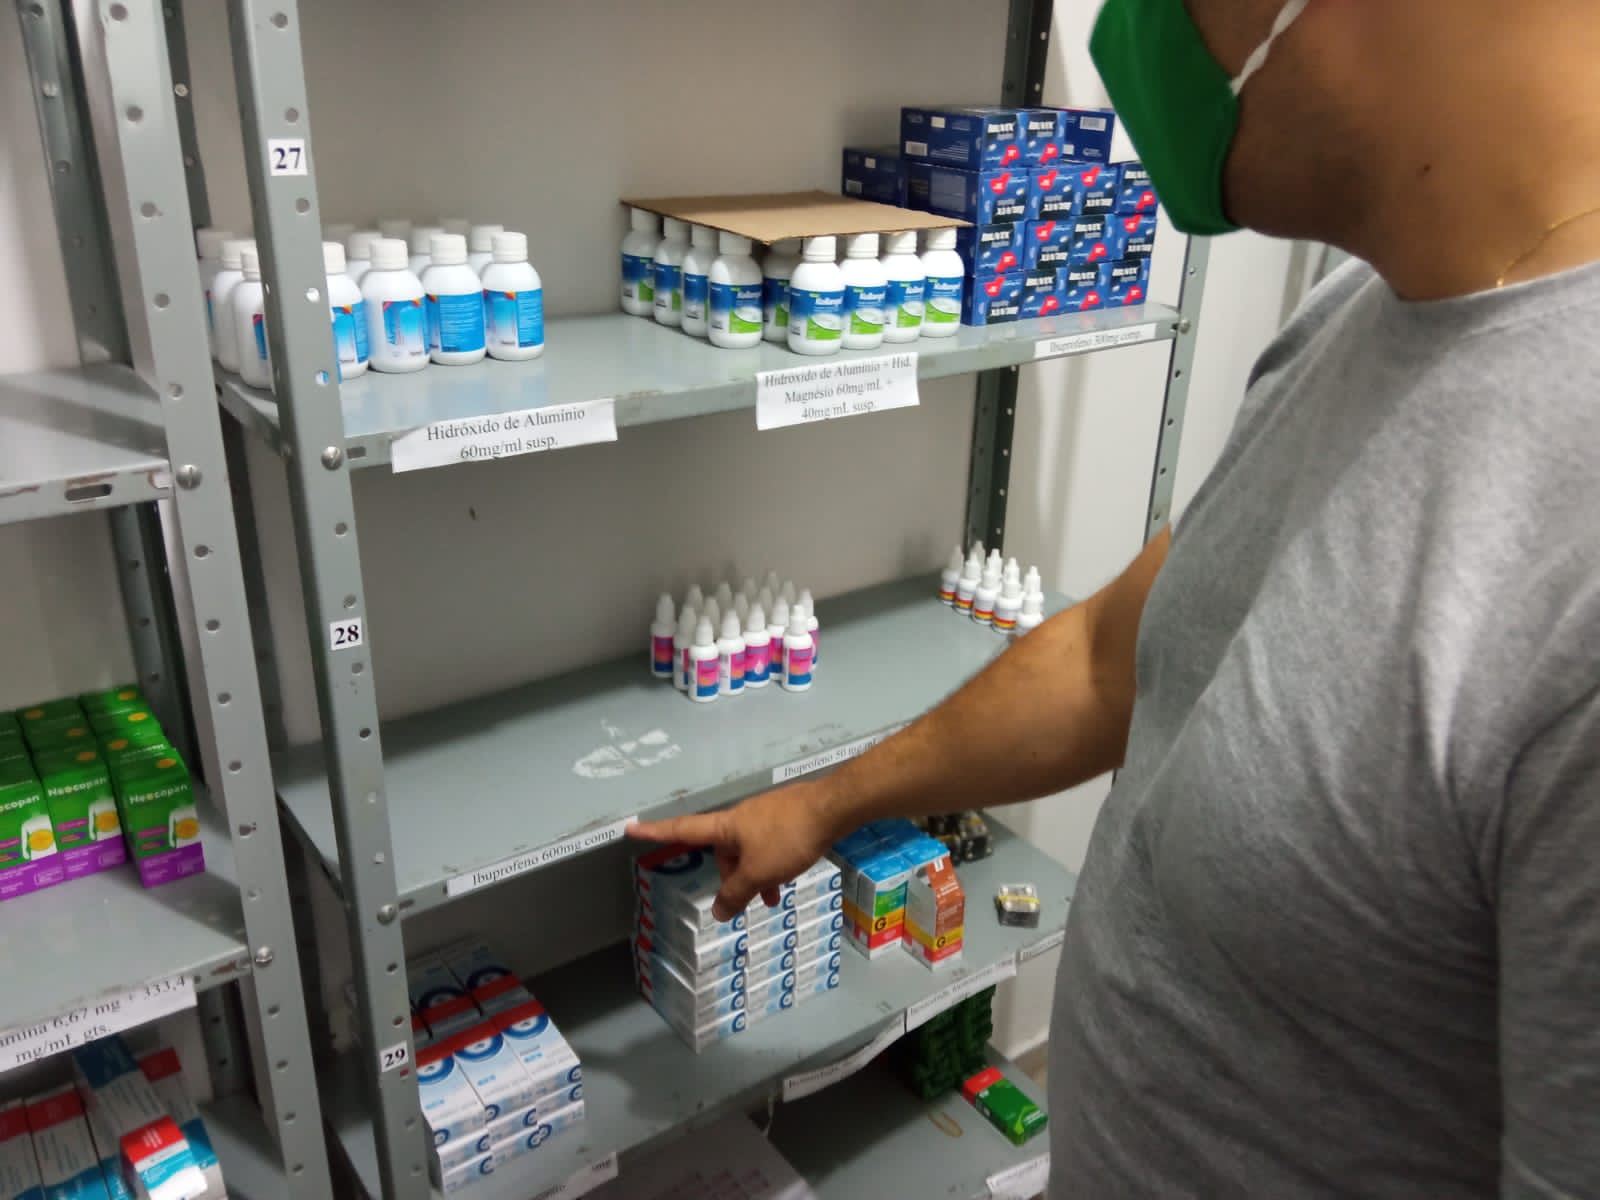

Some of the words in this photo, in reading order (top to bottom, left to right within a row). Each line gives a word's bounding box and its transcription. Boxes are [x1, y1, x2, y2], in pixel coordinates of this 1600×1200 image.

[274, 147, 301, 169] 27
[820, 368, 832, 380] de
[853, 399, 876, 413] susp.
[504, 417, 521, 431] de
[526, 435, 559, 451] susp.
[335, 624, 359, 645] 28
[784, 755, 834, 778] Ibuprofeno
[473, 855, 539, 886] Ibuprofeno
[541, 842, 582, 861] 600mg
[584, 828, 618, 847] comp.
[53, 1006, 89, 1028] 6,67
[95, 1000, 120, 1016] mg
[83, 1024, 112, 1043] gts.
[384, 1048, 405, 1066] 29
